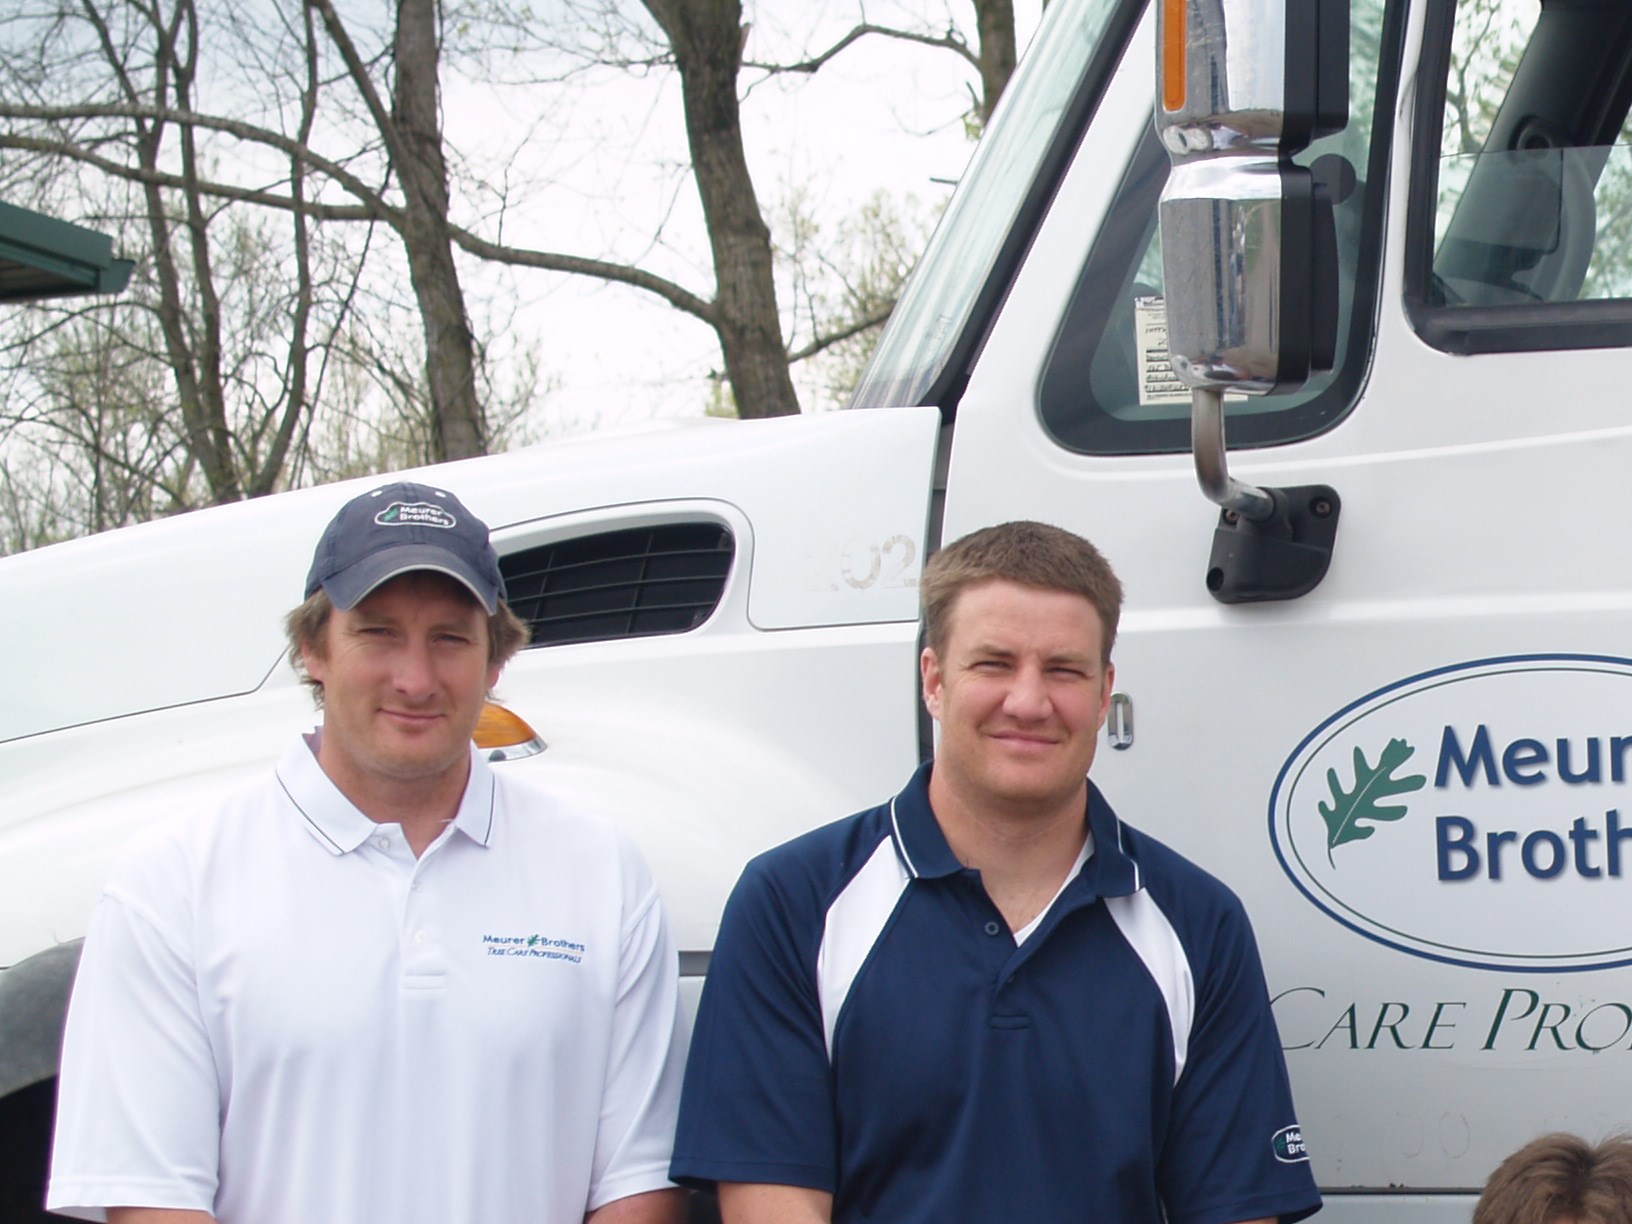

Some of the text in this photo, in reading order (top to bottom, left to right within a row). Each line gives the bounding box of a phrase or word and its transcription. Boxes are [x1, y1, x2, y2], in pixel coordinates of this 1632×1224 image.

[400, 506, 443, 516] Meurer
[399, 513, 450, 526] Brothers
[483, 934, 585, 952] Meurer Brothers
